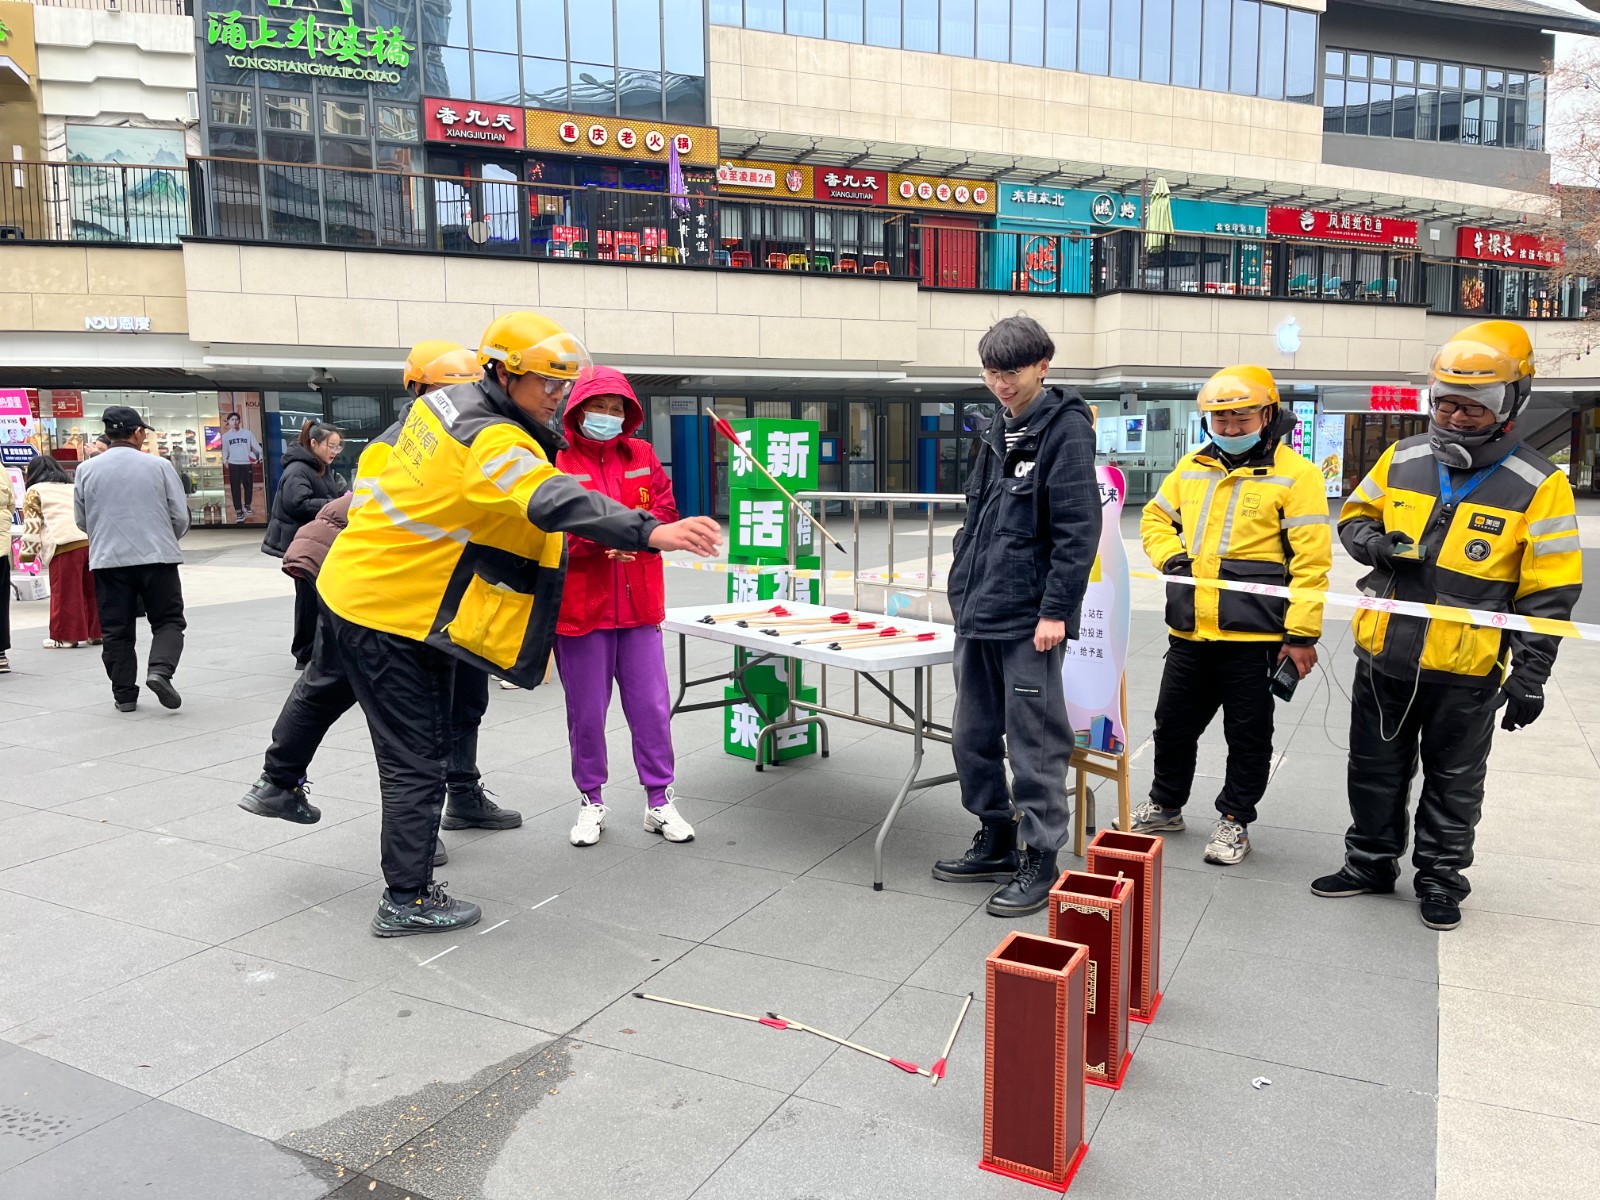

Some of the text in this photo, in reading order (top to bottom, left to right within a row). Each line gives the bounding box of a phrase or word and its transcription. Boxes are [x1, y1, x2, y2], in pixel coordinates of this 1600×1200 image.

[225, 54, 401, 84] YONGSHANGWAIPOQIAO
[436, 106, 516, 131] 香九天
[446, 128, 506, 142] XIANGJIUTIAN
[563, 125, 689, 150] 重庆老火锅
[824, 173, 879, 190] 香九天
[902, 183, 986, 201] 重庆老火锅
[1012, 189, 1065, 206] 来自东北
[766, 431, 810, 479] 新
[739, 500, 784, 548] 活
[1359, 597, 1399, 612] 安全
